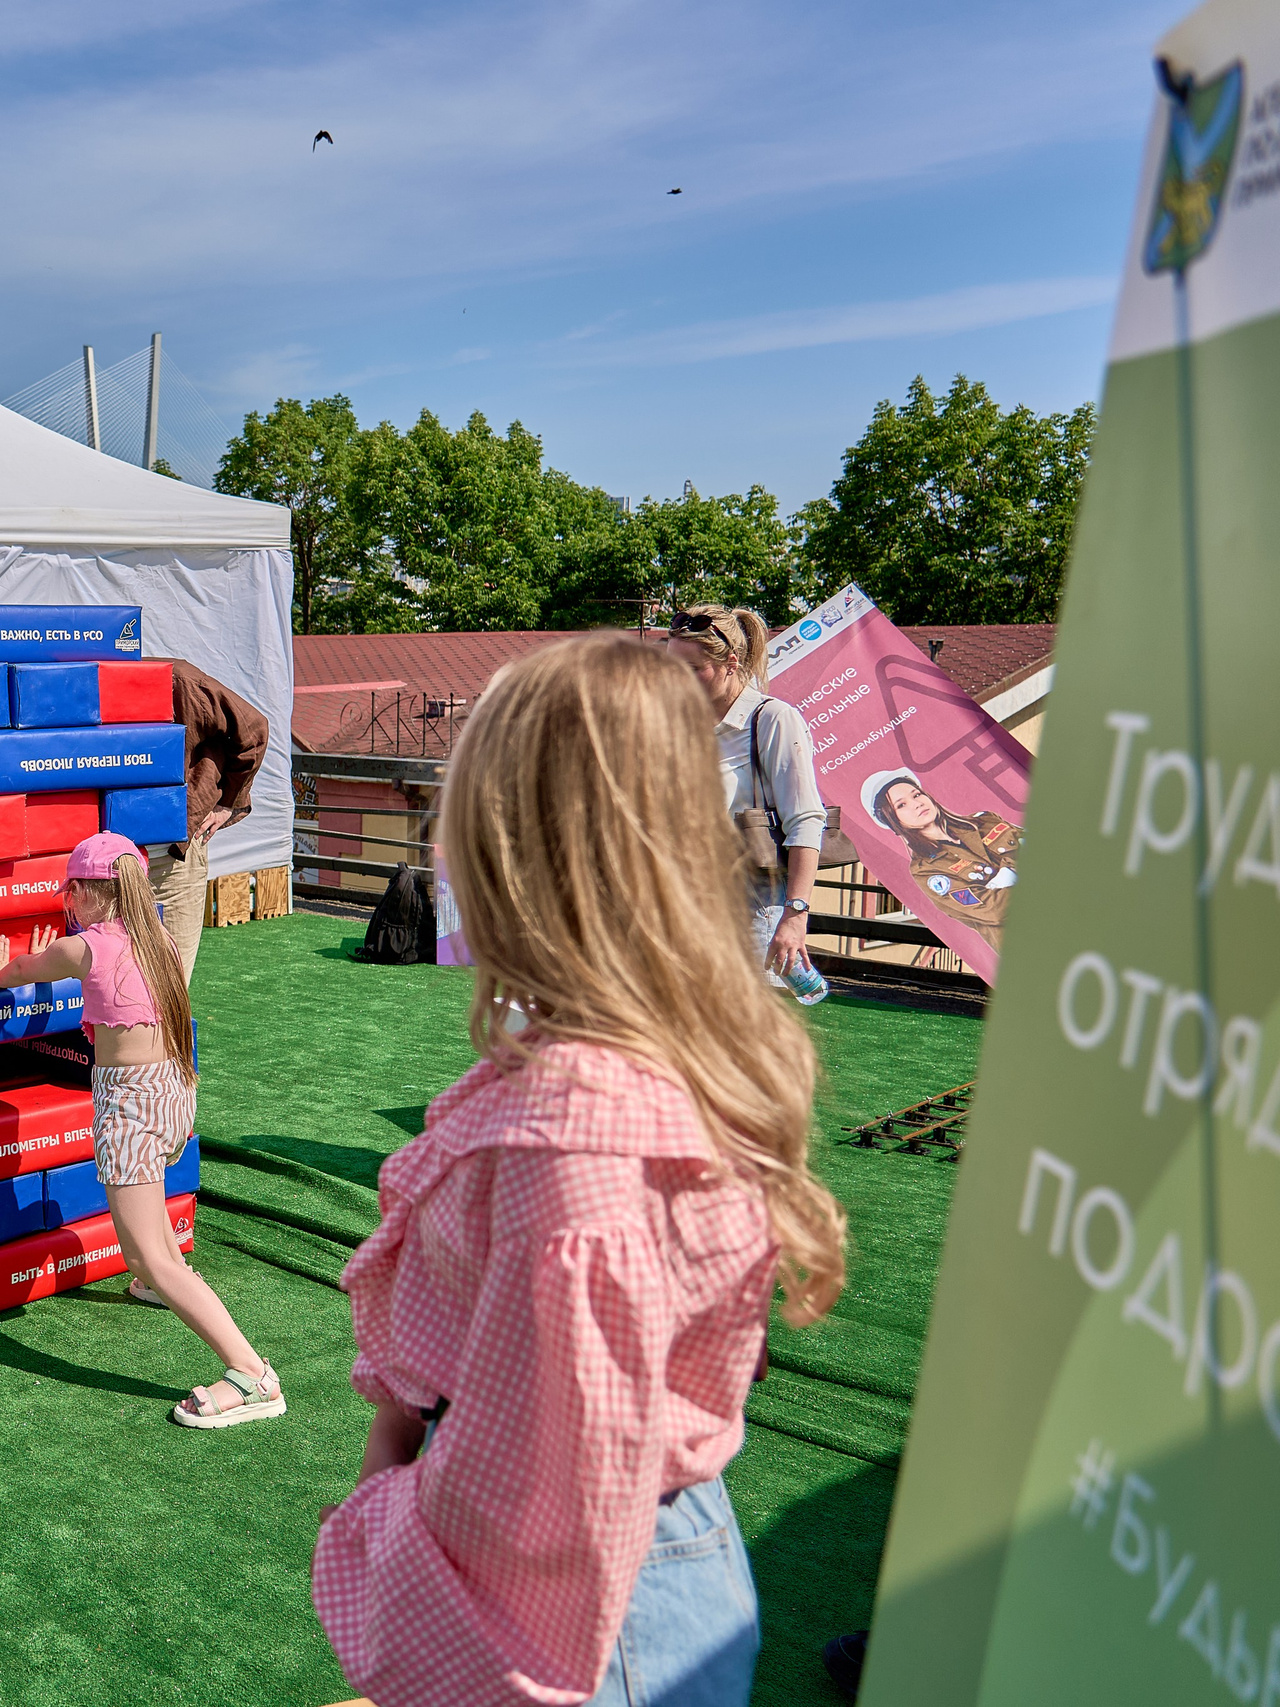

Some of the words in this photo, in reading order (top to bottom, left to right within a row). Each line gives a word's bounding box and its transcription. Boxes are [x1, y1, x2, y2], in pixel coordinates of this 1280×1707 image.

[0, 629, 44, 643] ВАЖНО,
[45, 629, 72, 641] ЕСТЬ
[73, 629, 82, 641] В
[795, 667, 858, 713] нческие
[807, 683, 871, 731] ительные
[819, 705, 918, 776] #СоздаемБудущее
[20, 757, 74, 772] ЛЮБОВЬ
[76, 755, 121, 769] ПЕРВАЯ
[124, 753, 153, 766] ТВОЯ
[11, 879, 60, 896] РАЗРЫВ
[31, 1040, 89, 1066] СТУДОТРЯДЫ
[11, 1266, 44, 1285] БЫТЬ
[47, 1262, 55, 1275] В
[57, 1243, 122, 1274] ДВИЖЕНИИ
